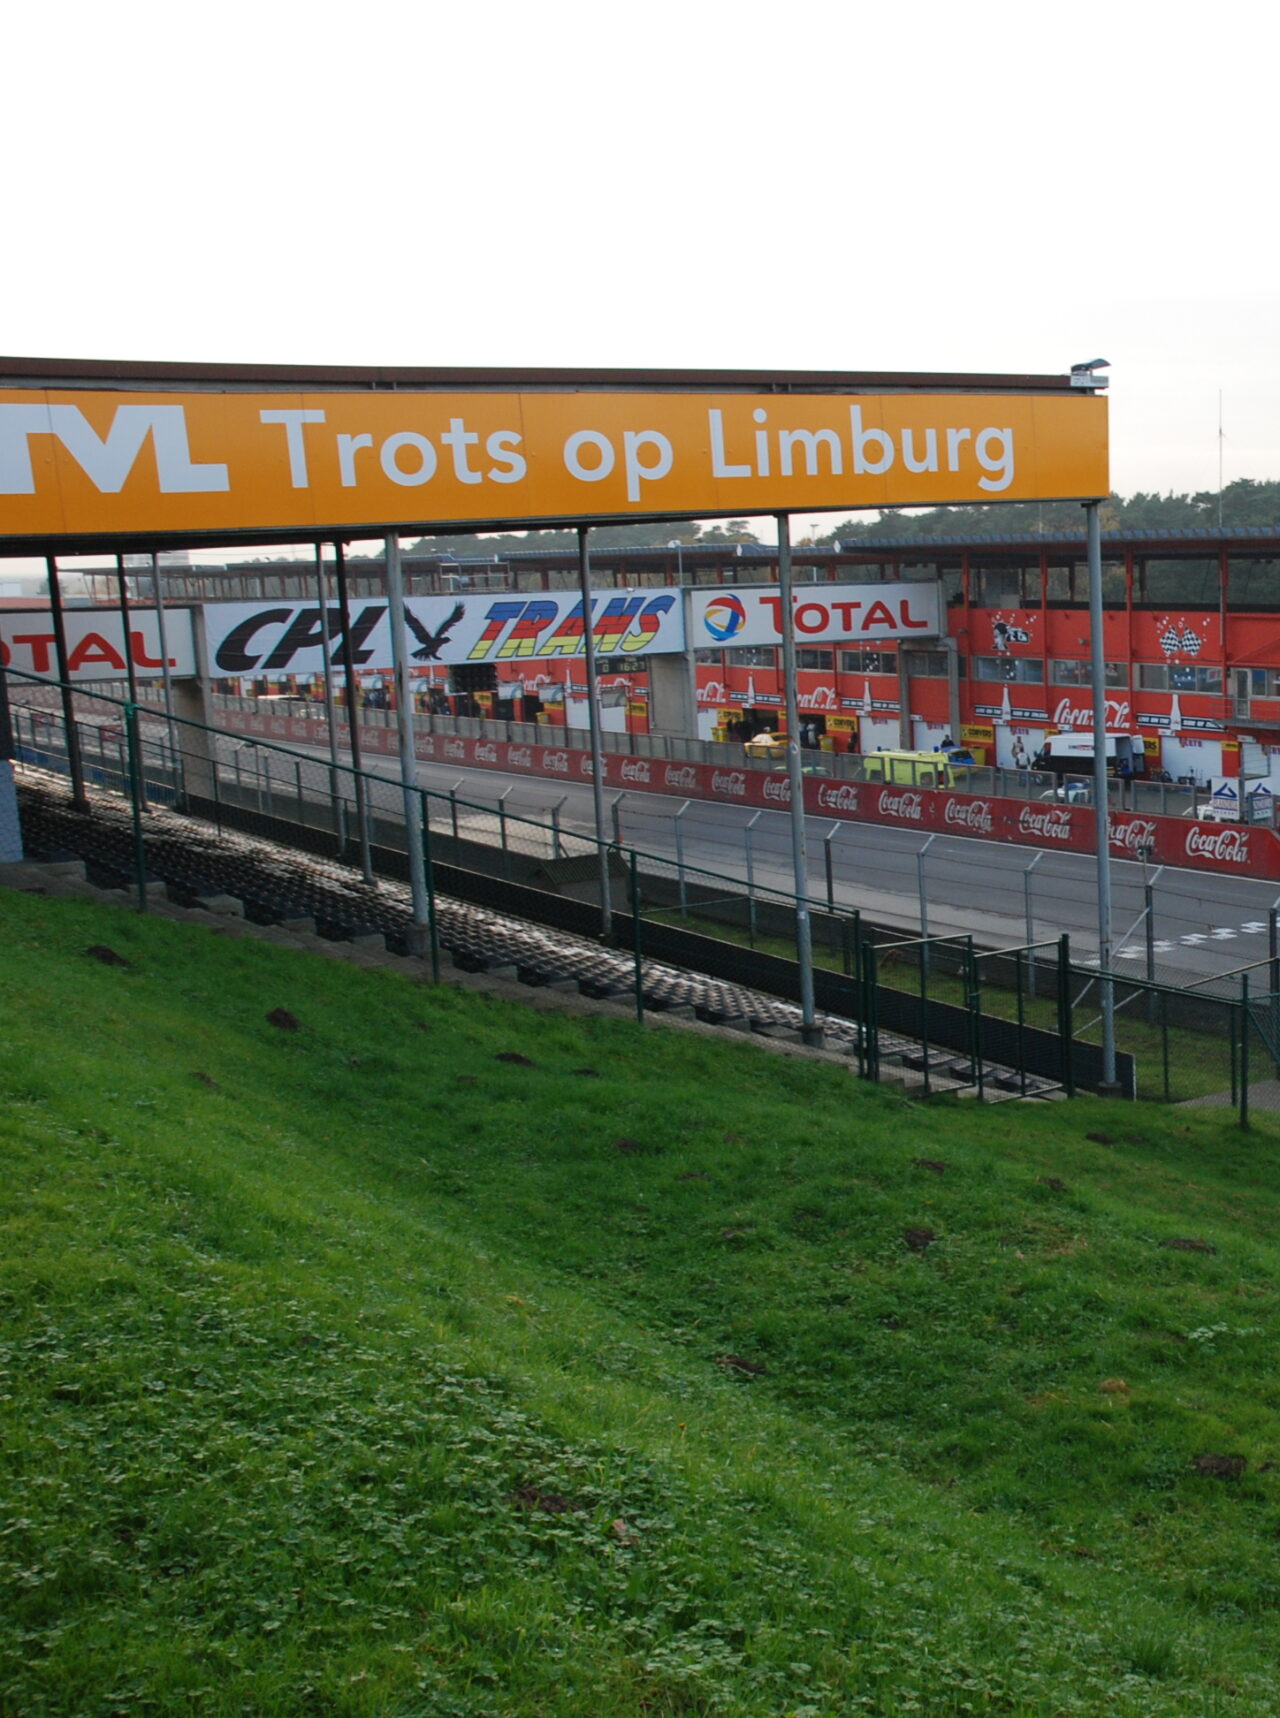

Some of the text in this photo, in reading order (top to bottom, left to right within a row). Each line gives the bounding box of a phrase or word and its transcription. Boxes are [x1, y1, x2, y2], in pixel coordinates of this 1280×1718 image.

[260, 410, 526, 488] Trots
[564, 430, 673, 501] op
[709, 405, 1014, 491] Limburg
[467, 595, 676, 660] TRANS
[760, 596, 928, 635] TOTAL
[0, 631, 176, 672] TAL
[1186, 826, 1249, 863] Coca-Cola
